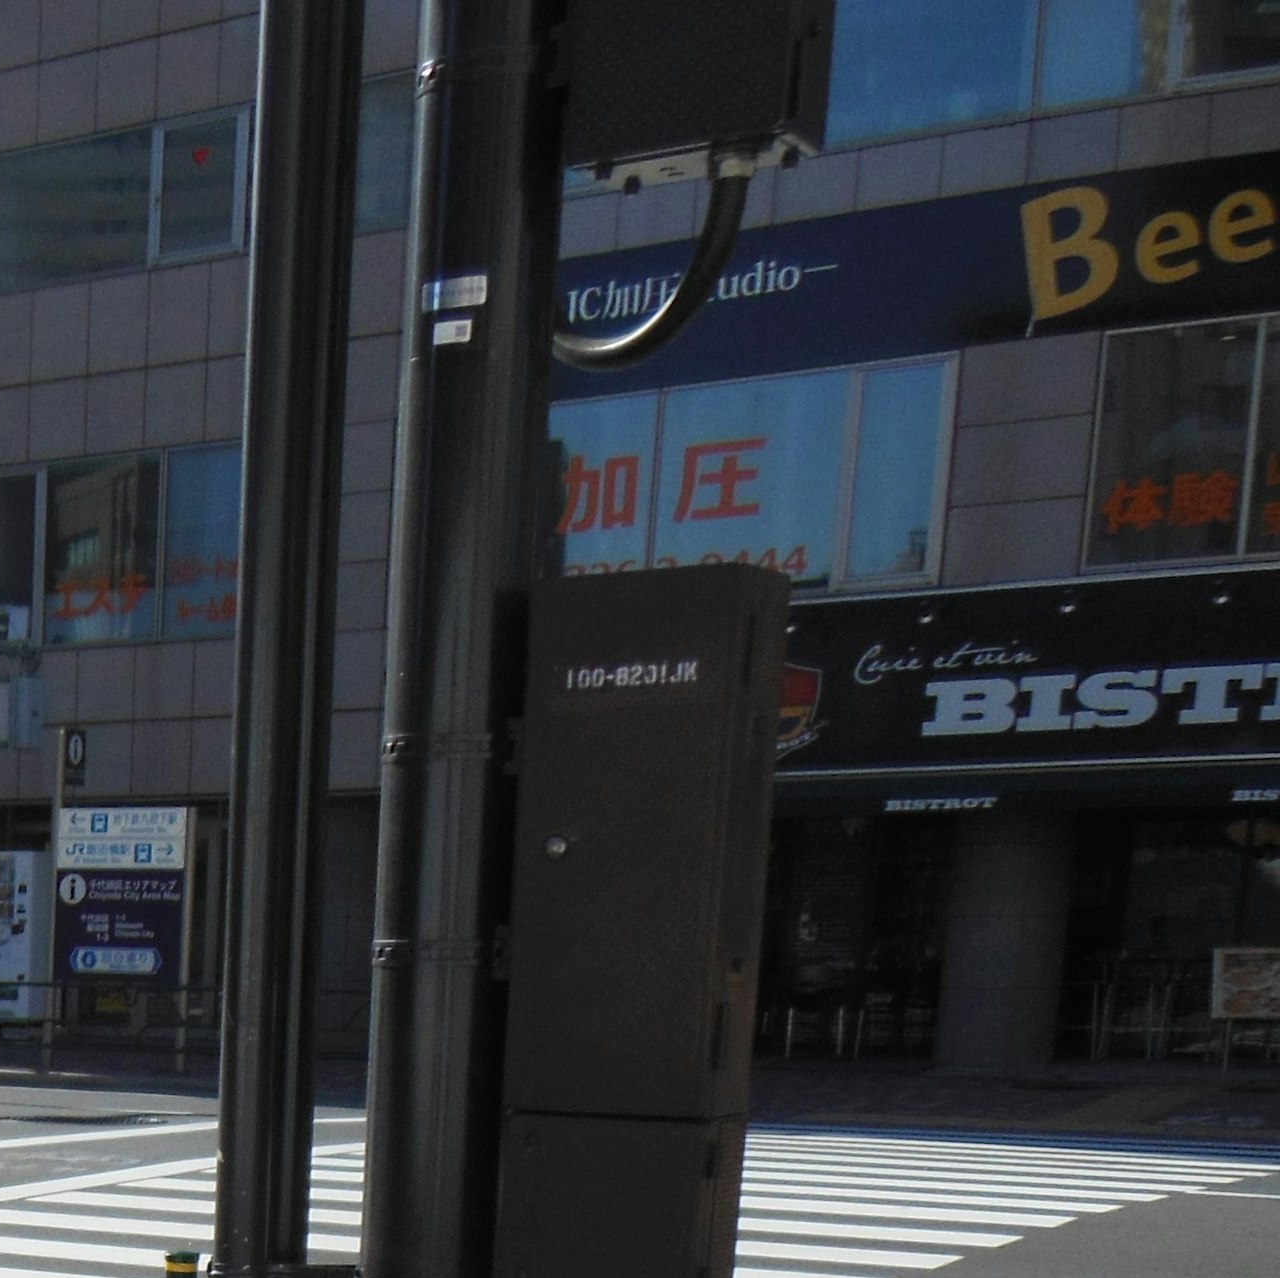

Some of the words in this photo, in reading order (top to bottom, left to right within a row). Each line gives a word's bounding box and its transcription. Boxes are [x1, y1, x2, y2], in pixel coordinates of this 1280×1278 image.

[555, 436, 766, 535] 加圧
[53, 572, 150, 620] エステ
[921, 663, 1280, 737] BIST
[884, 795, 998, 812] BISTROT
